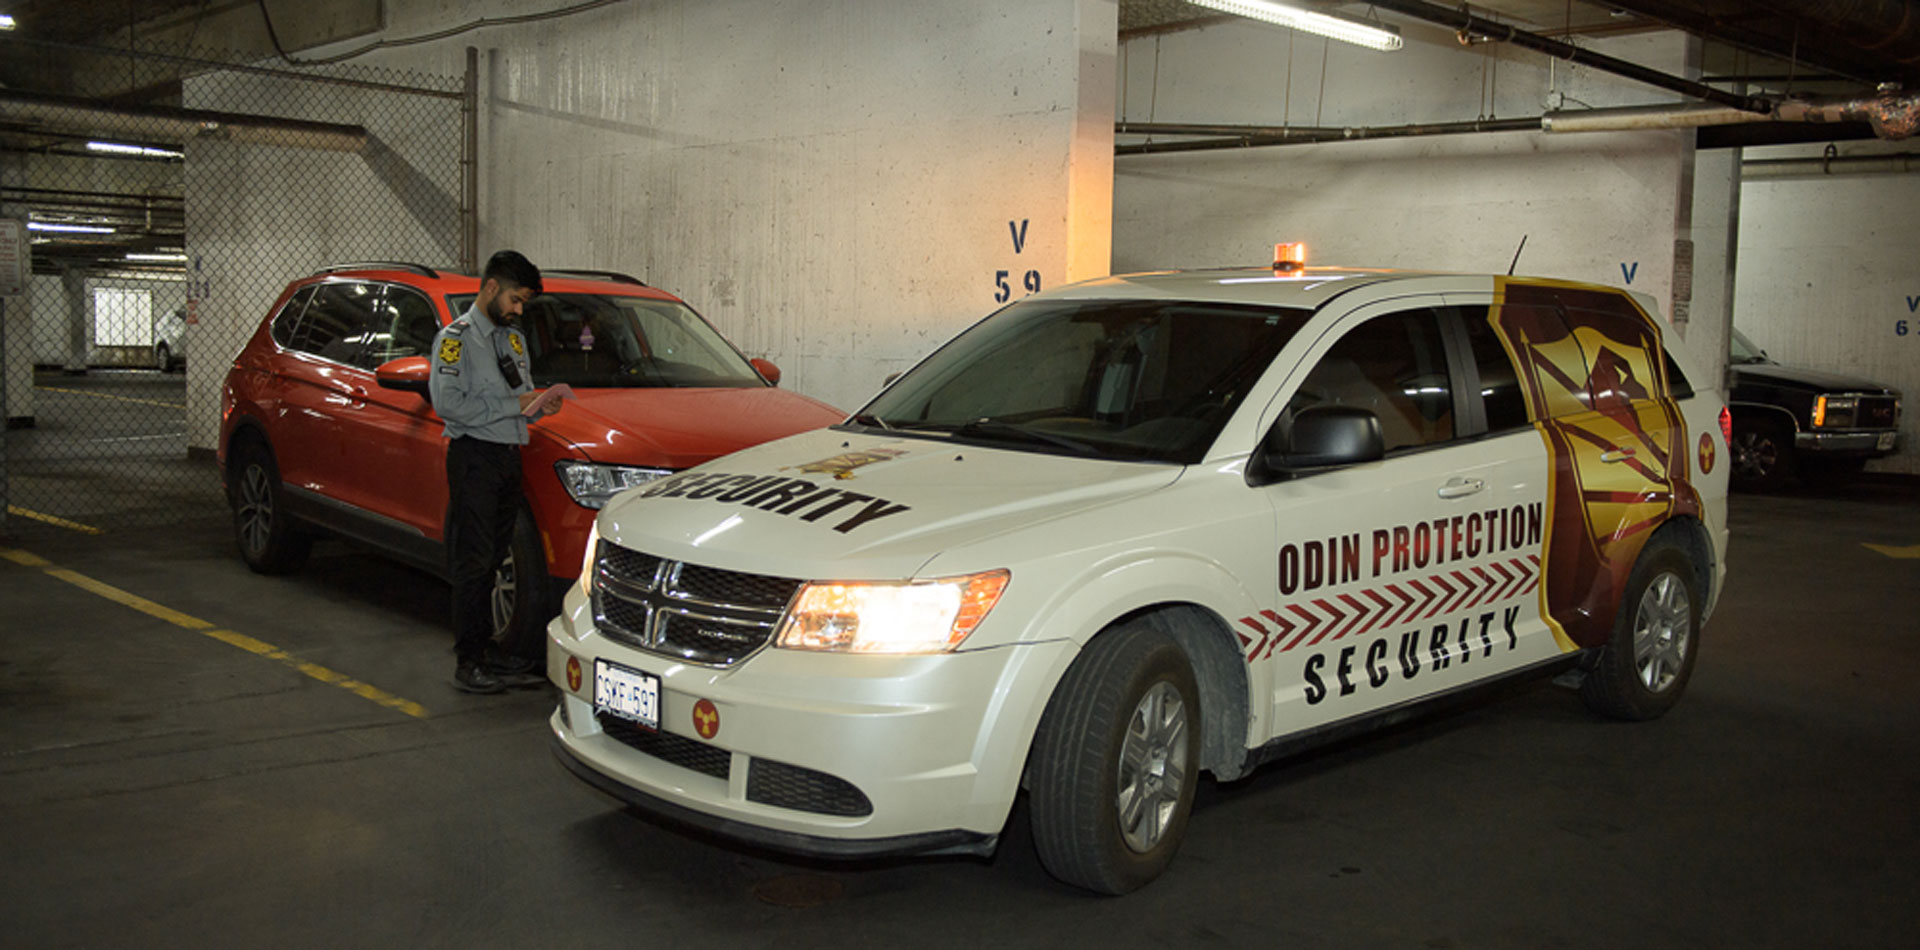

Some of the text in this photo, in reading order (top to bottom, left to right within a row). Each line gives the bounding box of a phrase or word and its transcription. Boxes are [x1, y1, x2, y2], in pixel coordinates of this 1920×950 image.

[1009, 219, 1029, 254] V
[1620, 262, 1638, 285] V
[640, 473, 912, 534] SECURITY
[1278, 502, 1542, 596] ODIN PROTECTION
[1303, 605, 1520, 706] SECURITY
